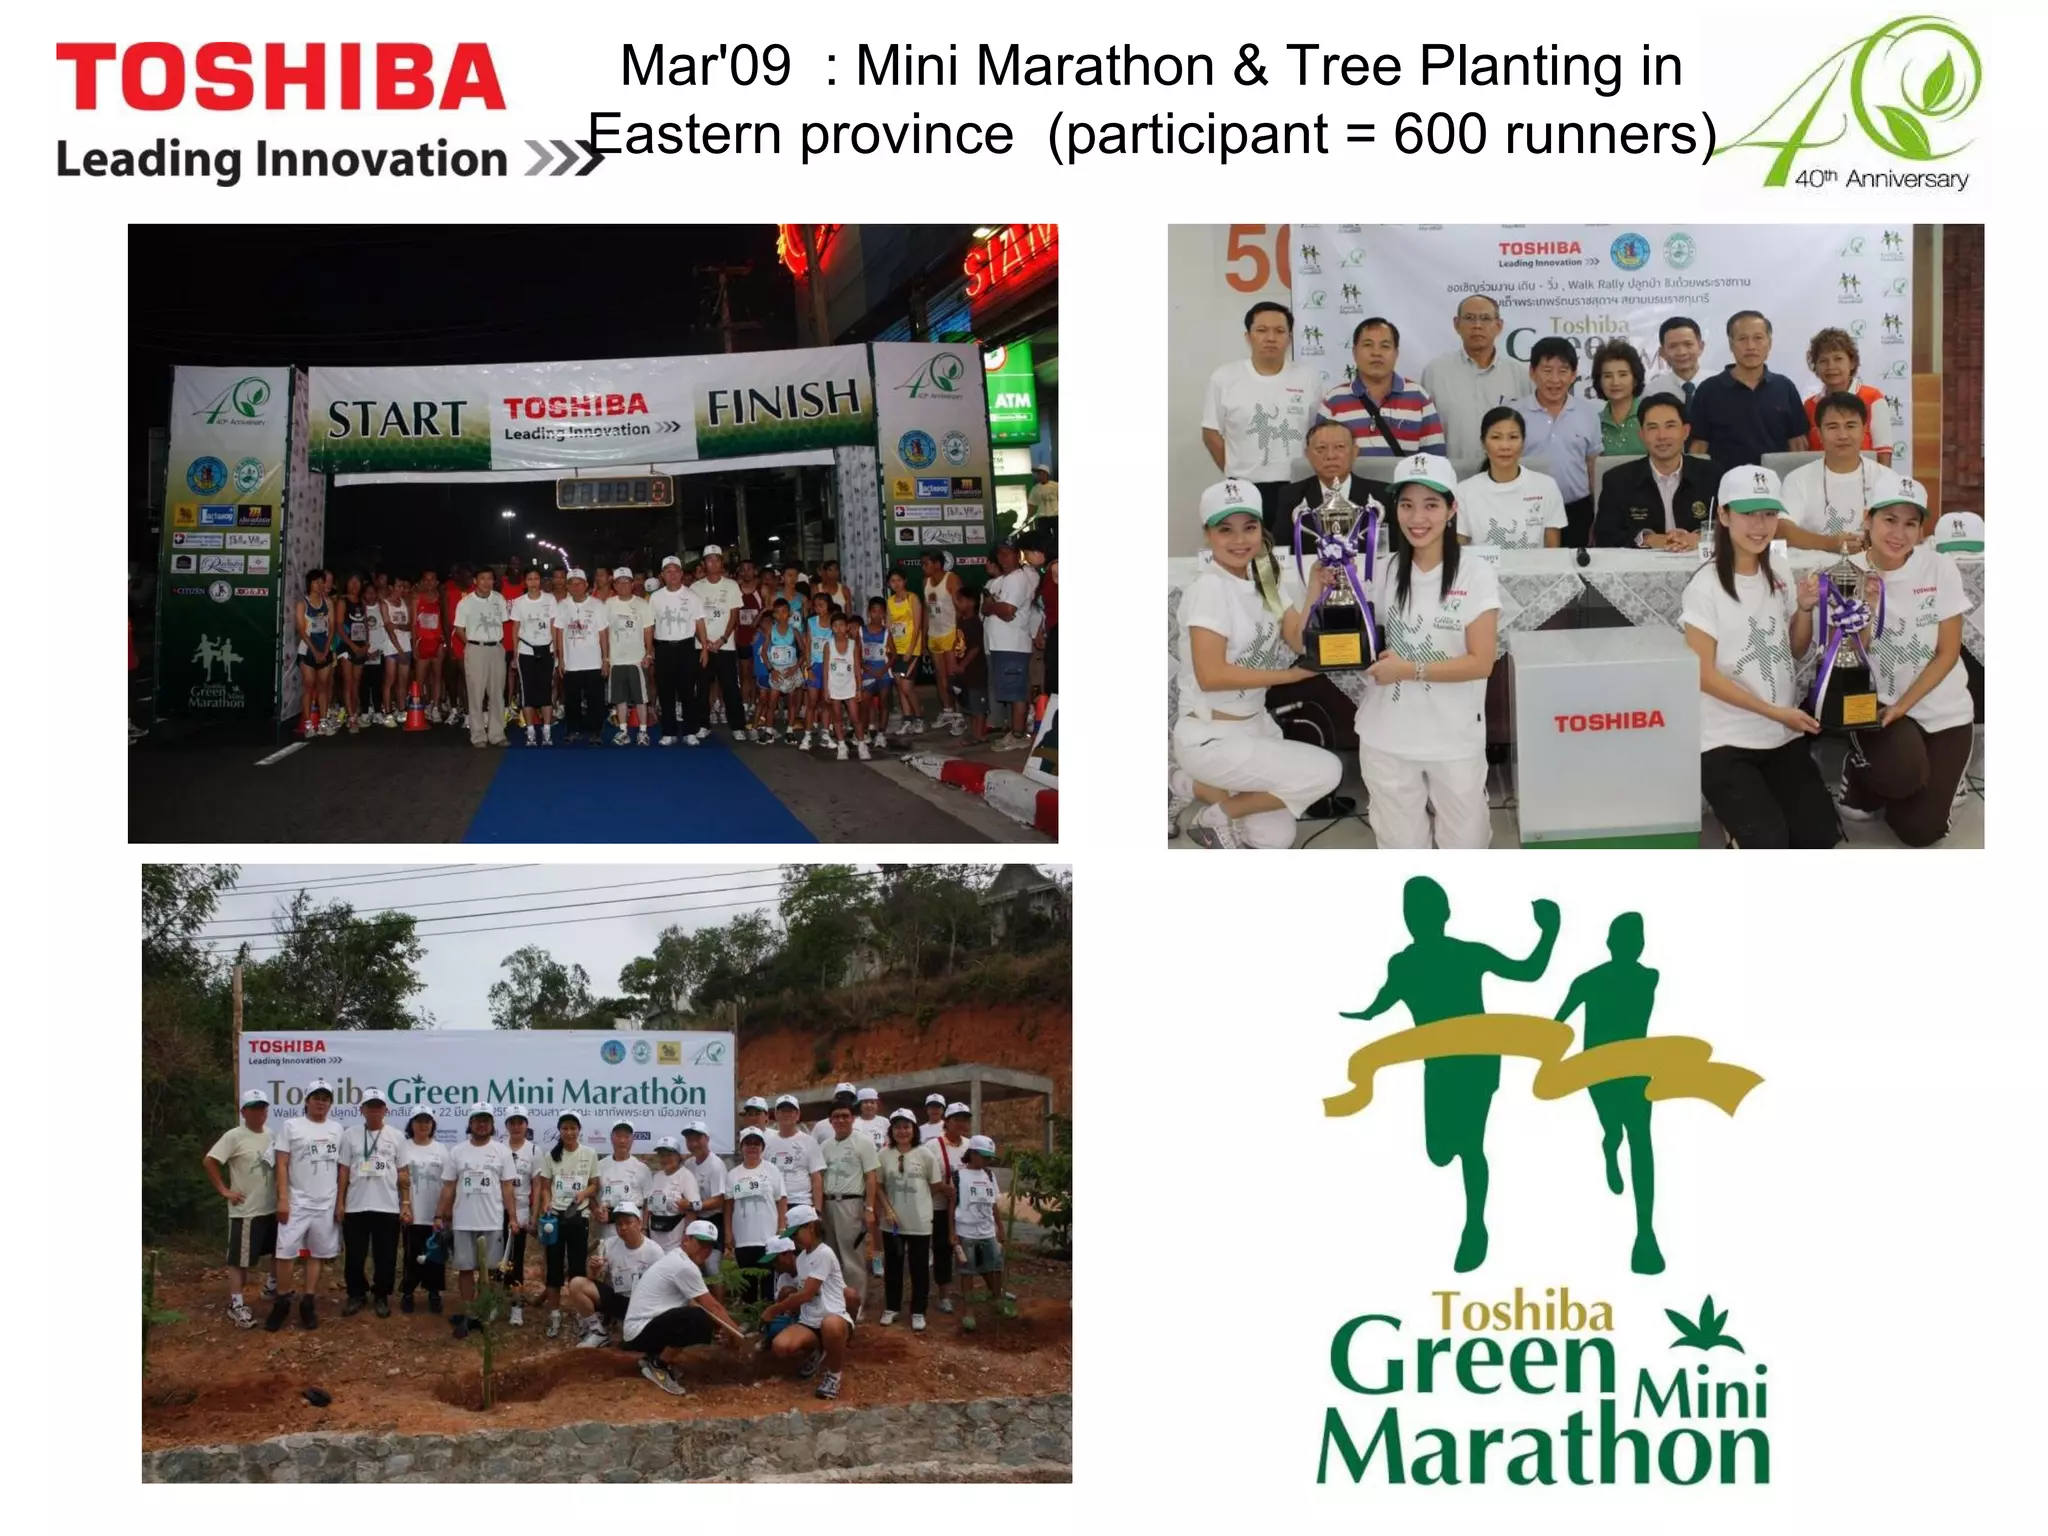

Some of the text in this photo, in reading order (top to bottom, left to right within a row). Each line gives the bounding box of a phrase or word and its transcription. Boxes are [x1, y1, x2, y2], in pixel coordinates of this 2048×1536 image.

[1498, 241, 1582, 256] TOSHIBA
[1499, 258, 1583, 269] Leading Innovation
[1568, 279, 1595, 291] Walk
[1598, 278, 1625, 292] Rally
[1549, 314, 1630, 335] Toshiba
[503, 392, 649, 420] TOSHIBA
[708, 378, 861, 427] FINISH
[994, 392, 1032, 409] ATM
[328, 400, 468, 438] START
[504, 422, 651, 442] Leading Innovation
[1554, 710, 1666, 733] TOSHIBA
[248, 1039, 327, 1053] TOSHIBA
[248, 1055, 327, 1067] Leading Innovation
[387, 1077, 479, 1106] Green
[487, 1076, 554, 1106] Mini
[562, 1076, 707, 1107] Marathon
[273, 1108, 298, 1118] Walk
[440, 1108, 452, 1117] 22
[326, 1143, 337, 1153] 25
[375, 1161, 385, 1171] 39
[784, 1156, 793, 1164] 39
[464, 1177, 491, 1187] R 43
[556, 1180, 581, 1191] R 43
[749, 1181, 759, 1190] 39
